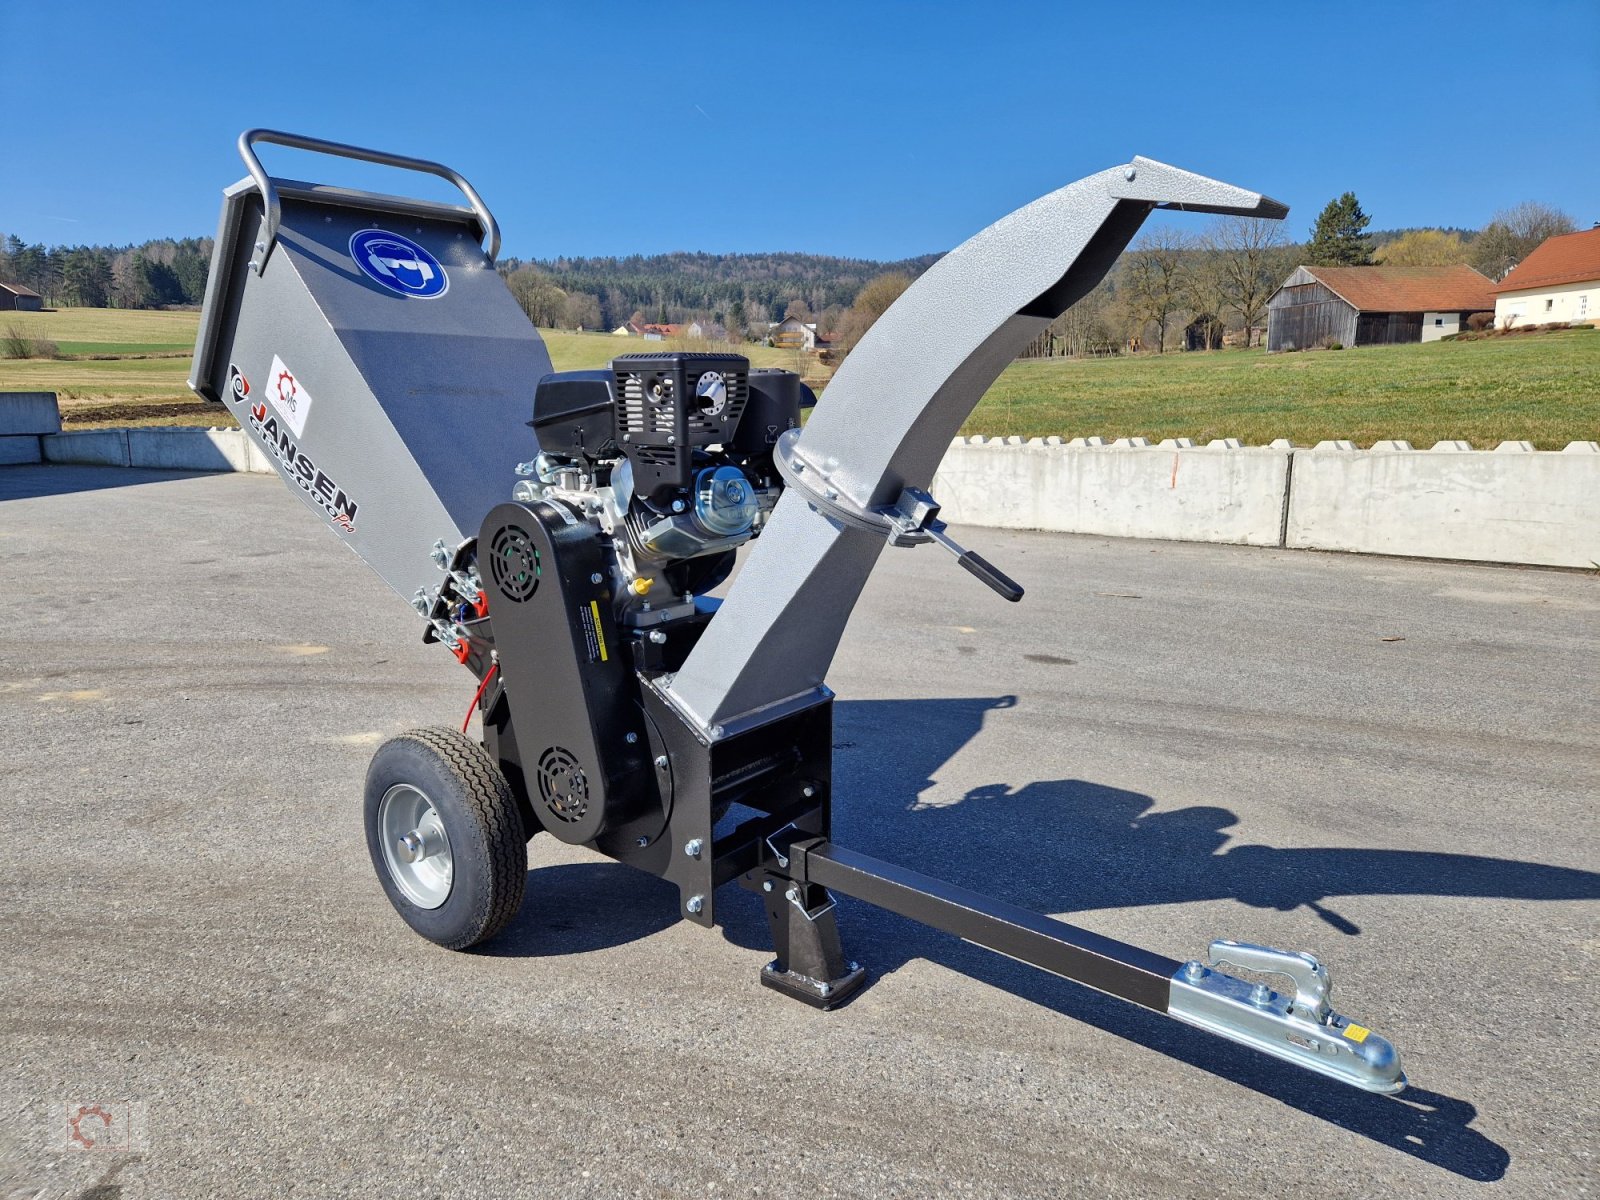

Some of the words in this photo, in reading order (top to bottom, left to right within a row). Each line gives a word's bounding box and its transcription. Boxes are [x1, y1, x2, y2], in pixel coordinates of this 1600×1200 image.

[285, 391, 298, 413] MS
[251, 402, 359, 523] JANSEN
[332, 513, 356, 533] Pro
